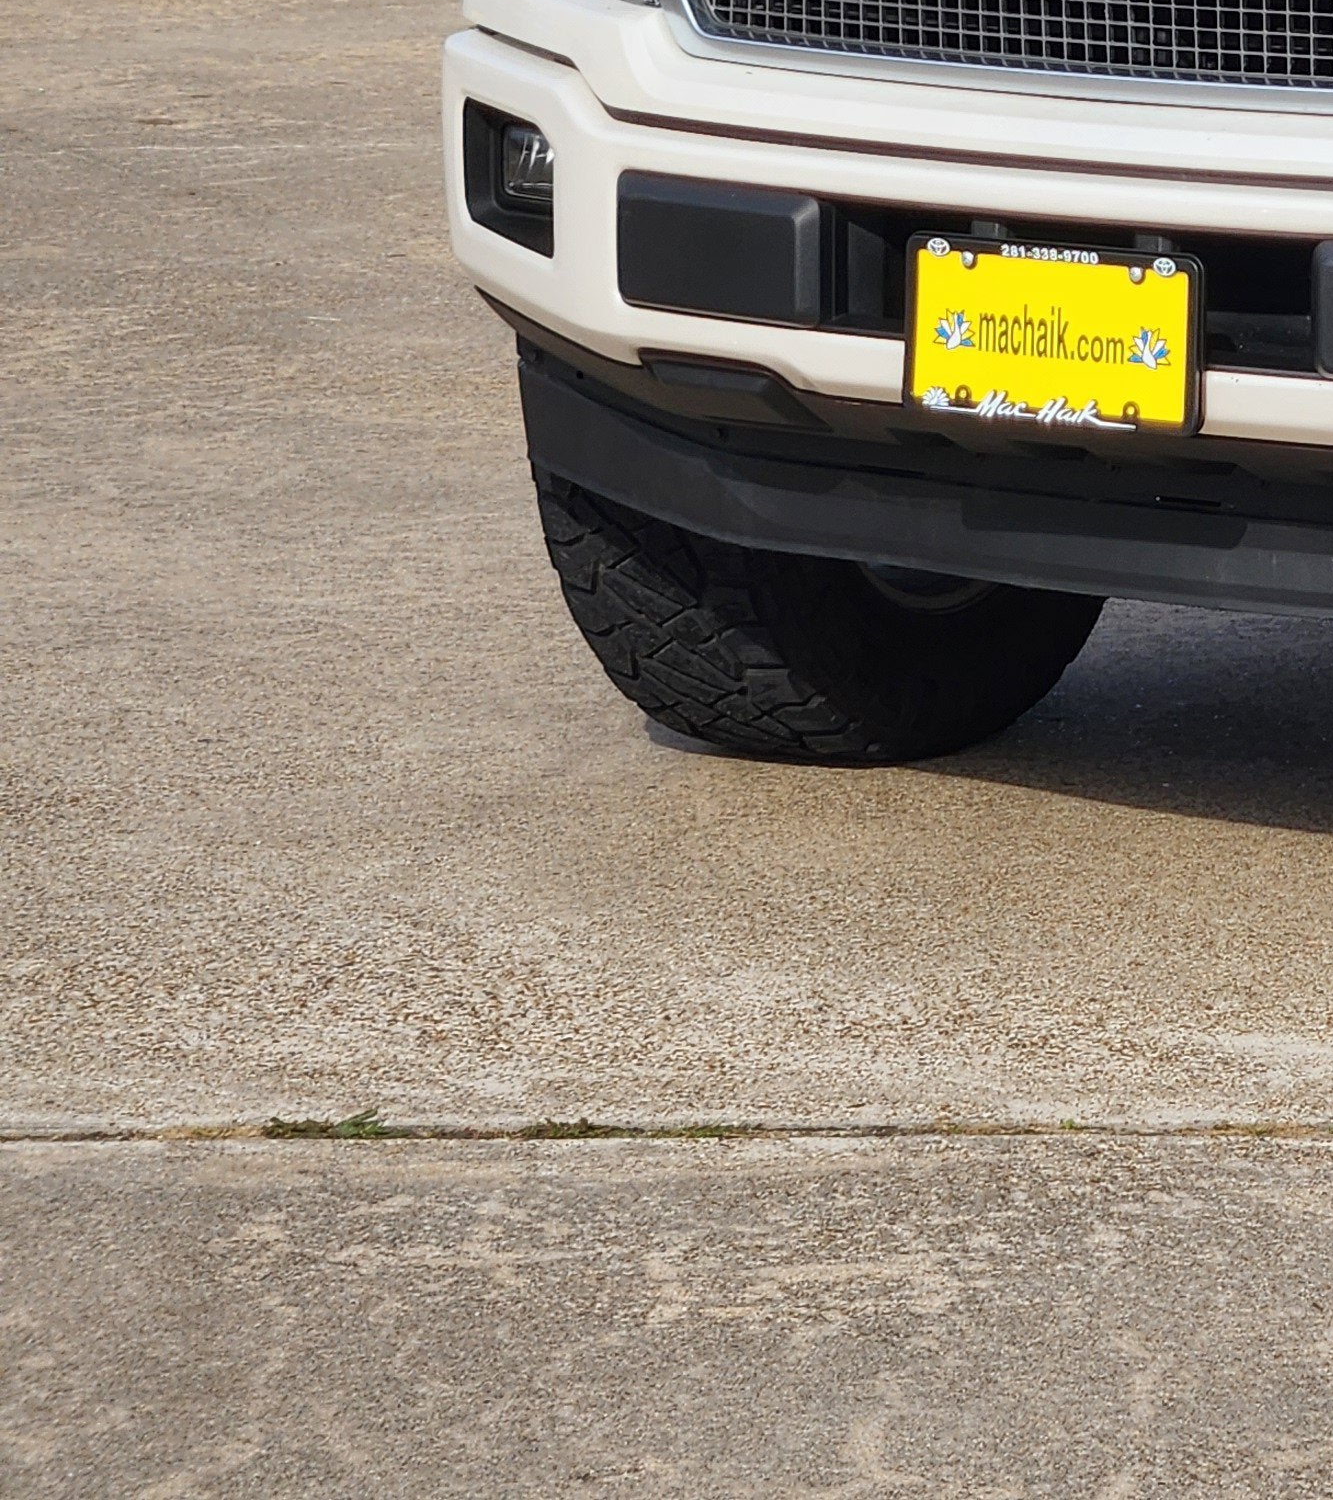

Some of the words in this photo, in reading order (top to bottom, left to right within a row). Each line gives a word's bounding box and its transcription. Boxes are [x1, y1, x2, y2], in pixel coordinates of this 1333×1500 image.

[978, 304, 1125, 365] machaik.com
[976, 390, 1027, 418] Mac
[1036, 395, 1103, 425] Haik
